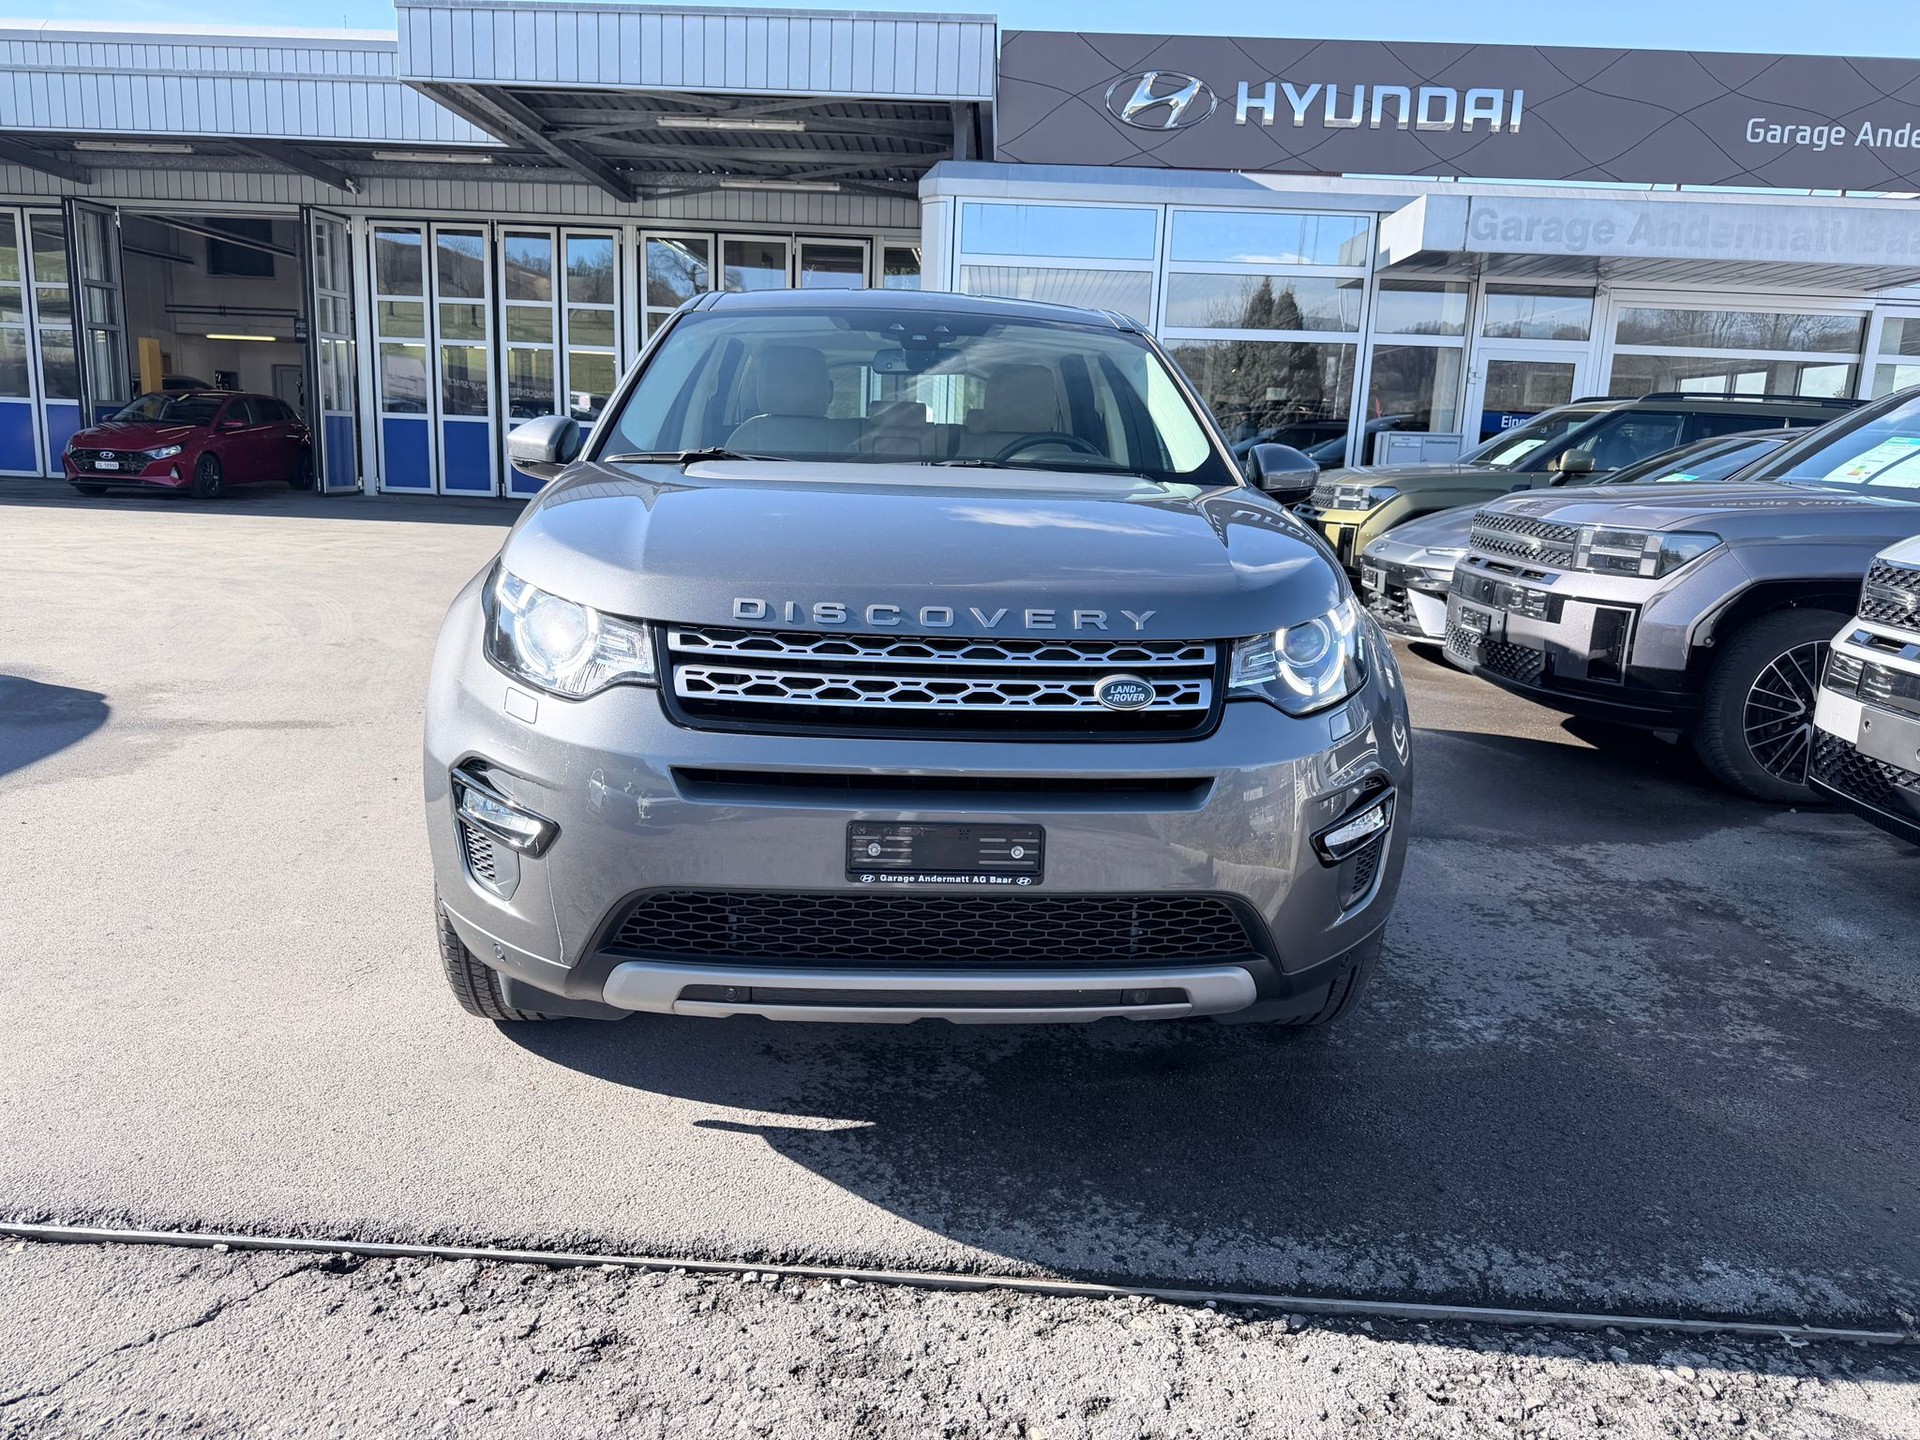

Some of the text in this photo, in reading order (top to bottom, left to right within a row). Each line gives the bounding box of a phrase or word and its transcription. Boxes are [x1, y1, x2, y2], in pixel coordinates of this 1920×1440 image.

[1234, 81, 1525, 134] HYUNDAI
[1745, 117, 1847, 151] Garage
[1471, 208, 1615, 251] Garage
[732, 597, 1157, 632] DISCOVERY
[1110, 685, 1137, 693] LAND
[1113, 693, 1145, 702] ROVER
[880, 874, 1013, 884] Garage Andermatt AG Baar
